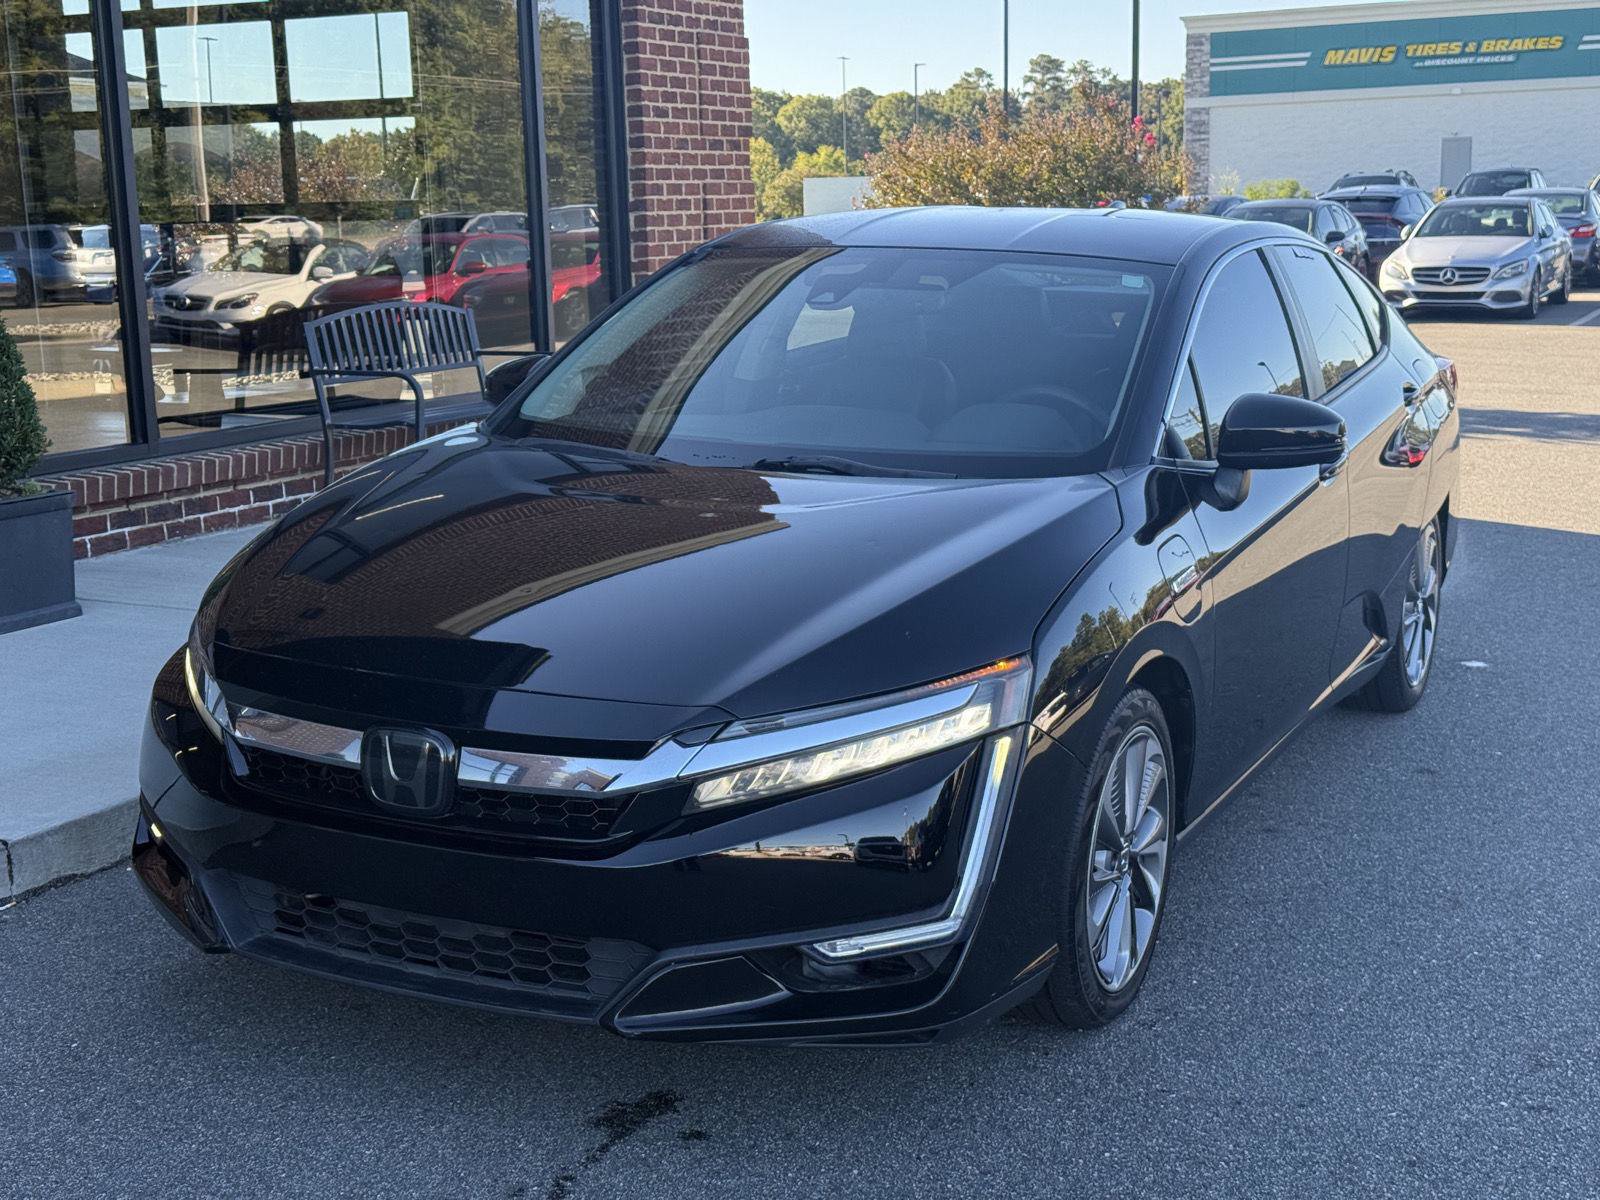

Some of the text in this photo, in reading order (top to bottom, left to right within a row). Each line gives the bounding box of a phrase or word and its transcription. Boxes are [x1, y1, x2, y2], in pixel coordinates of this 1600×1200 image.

[1324, 36, 1564, 64] MAVIS TIRES & BRAKES
[1424, 56, 1475, 66] DISCOUNT
[1477, 54, 1516, 63] PRICES
